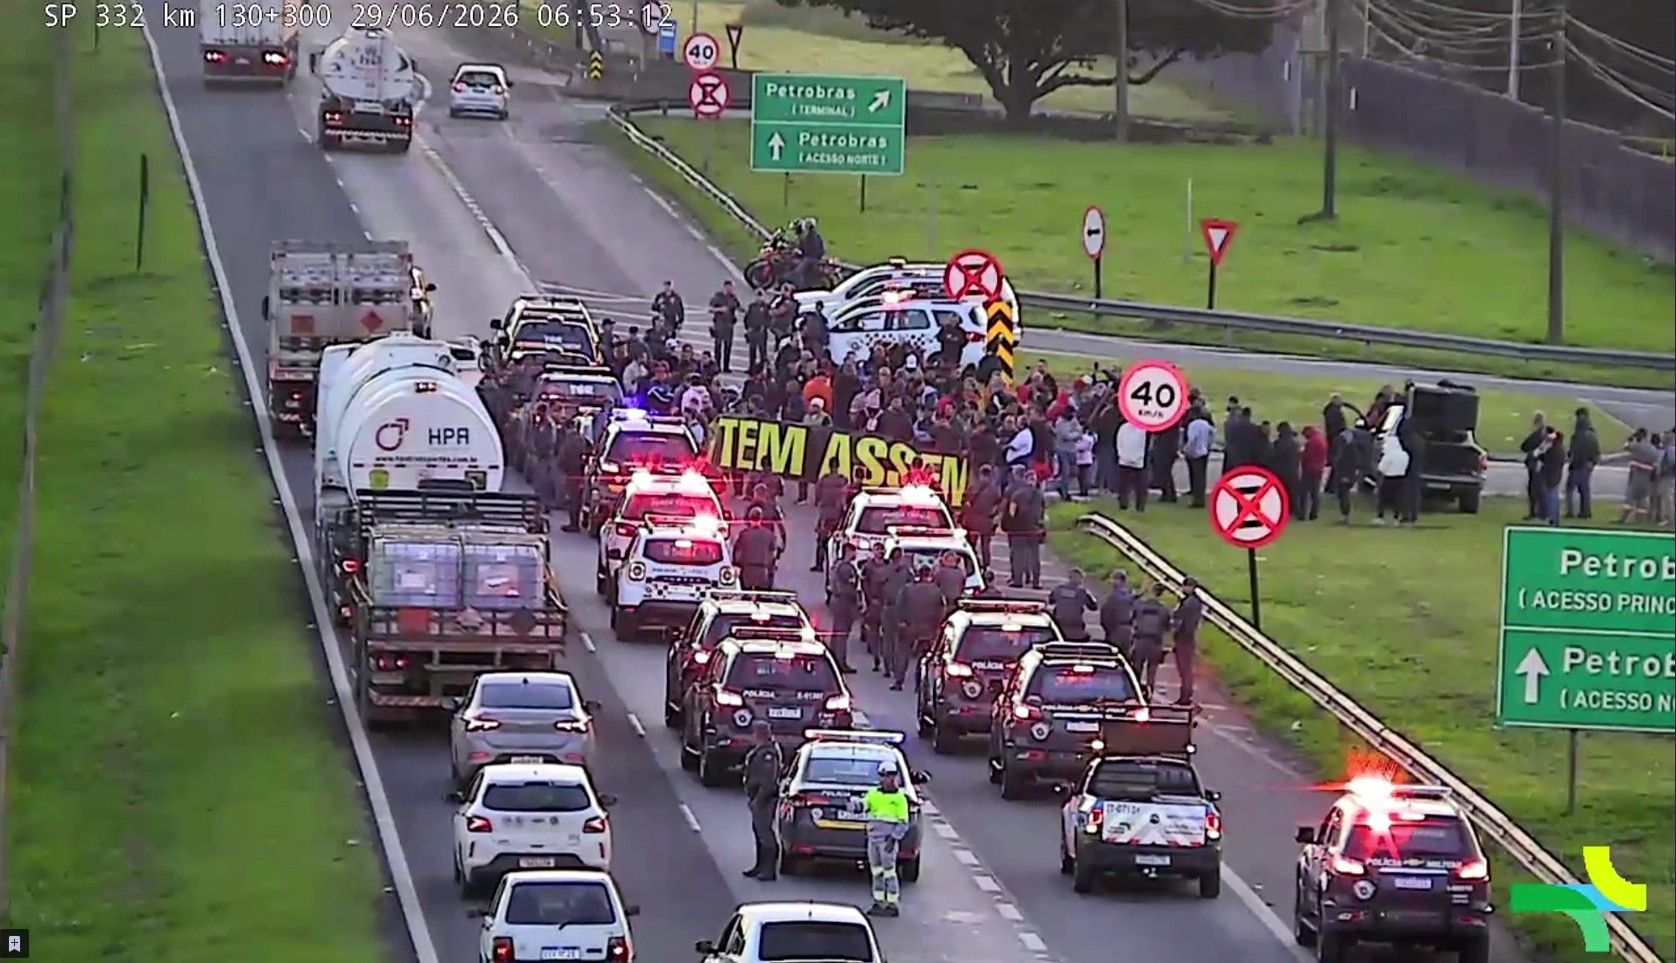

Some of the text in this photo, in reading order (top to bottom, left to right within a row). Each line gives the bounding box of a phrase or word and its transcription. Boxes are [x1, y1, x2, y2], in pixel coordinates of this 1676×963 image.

[689, 44, 714, 59] 40
[766, 83, 856, 99] Petrobras
[799, 132, 888, 148] Petrobras
[1131, 381, 1175, 408] 40
[428, 428, 469, 445] HPA
[718, 418, 808, 476] TEM
[1658, 694, 1675, 712] N
